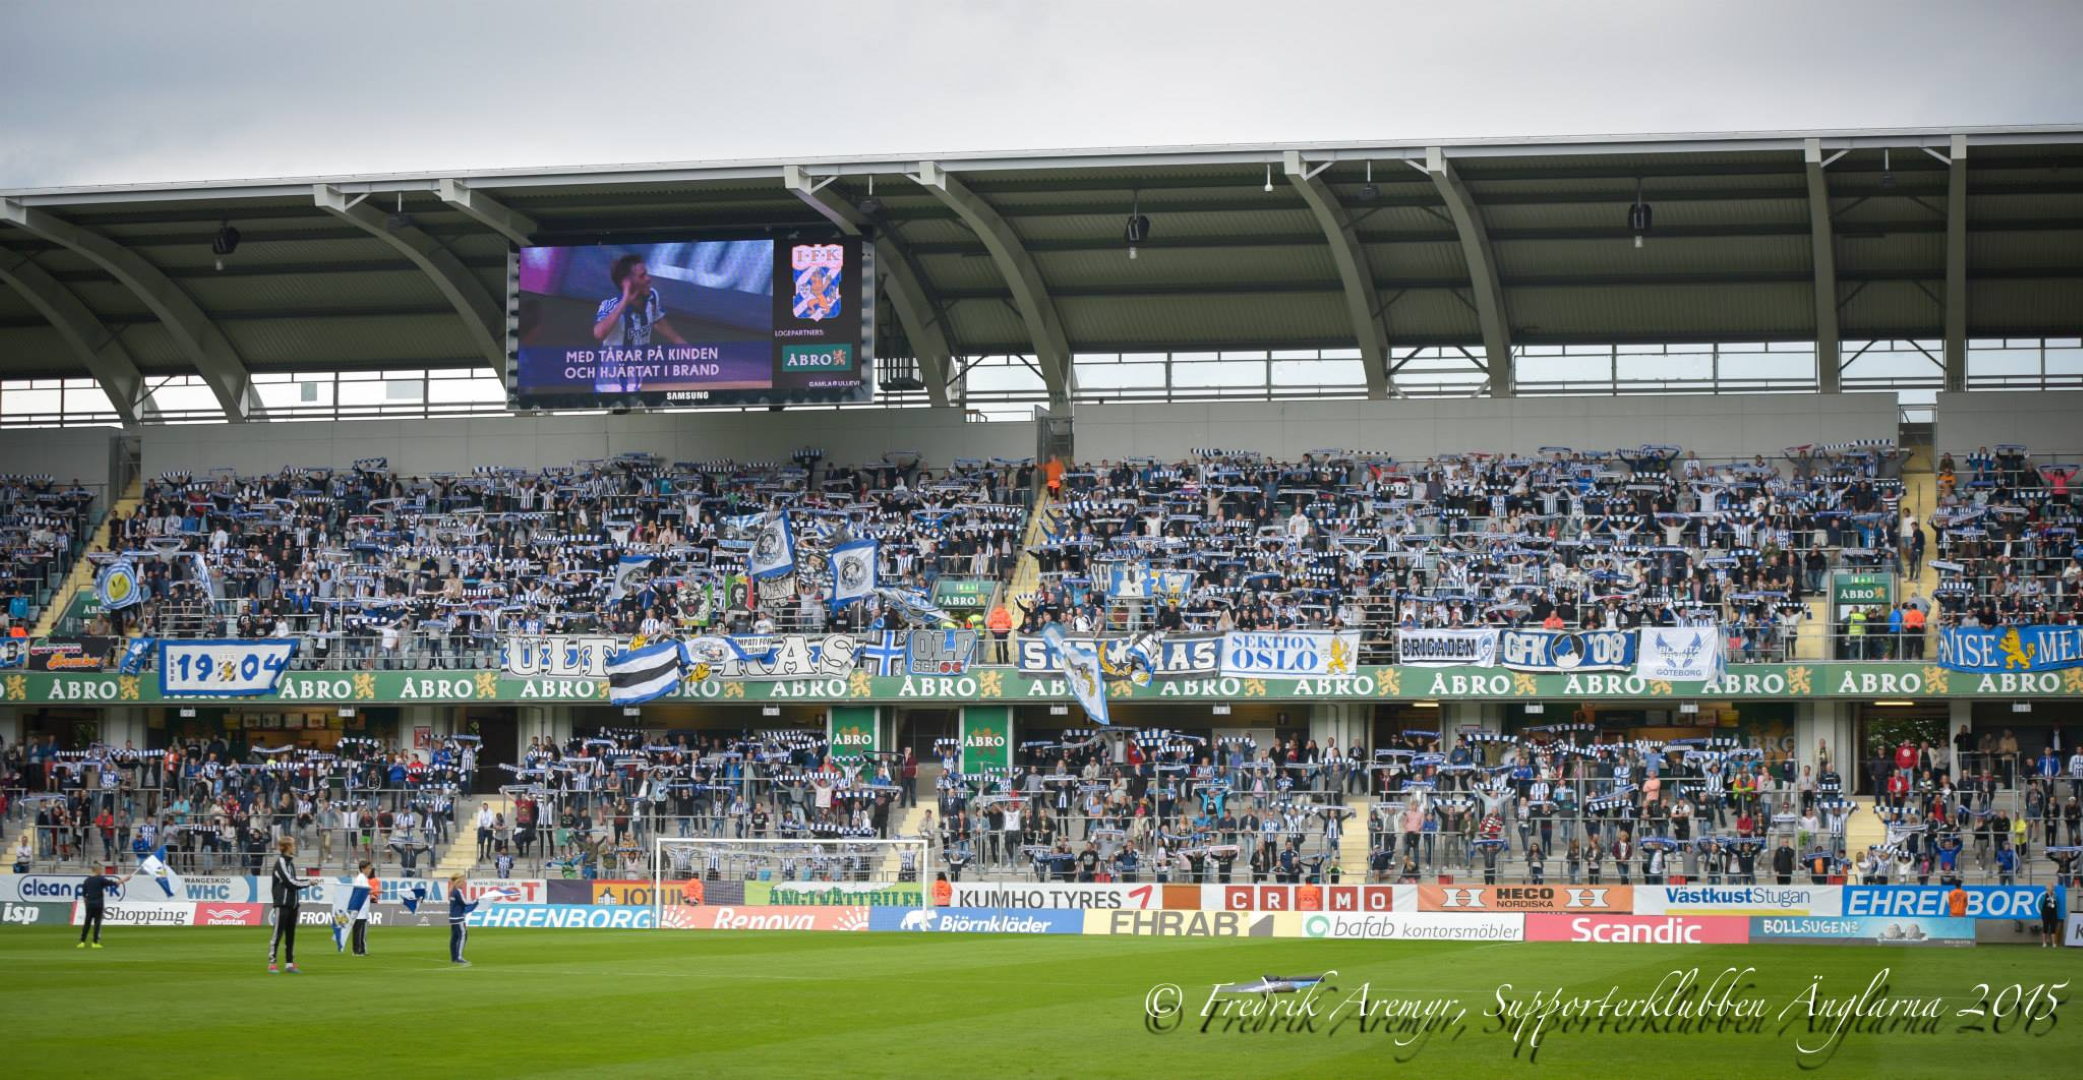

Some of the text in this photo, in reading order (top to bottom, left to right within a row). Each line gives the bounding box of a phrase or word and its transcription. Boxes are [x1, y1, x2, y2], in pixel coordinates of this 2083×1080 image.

[774, 329, 824, 338] LOGEPARTNERS
[566, 345, 718, 363] MED TÅRAR PÅ KINDEN
[787, 353, 832, 367] ÅBRO
[564, 364, 720, 379] OCH HJÄRTAT I BRAND
[666, 391, 710, 401] SAMSUNG
[943, 595, 977, 606] ÅBRO
[912, 630, 976, 661] OLD
[1231, 634, 1317, 649] SEKTION
[1402, 637, 1477, 659] BRIGADEN
[1503, 631, 1547, 666] GFK
[1938, 626, 1999, 667] NISE
[1231, 648, 1315, 671] OSLO
[1656, 668, 1703, 677] GÖTEBORG
[1838, 670, 1921, 693] ÅBRO
[48, 678, 118, 699] ÅBRO
[280, 677, 352, 699] ÅBRO
[399, 677, 473, 699] ÅBRO
[898, 675, 977, 697] ÅBRO
[1428, 673, 1520, 695] ÅBRO
[22, 880, 72, 897] clean
[184, 877, 232, 885] WANGESKOG
[186, 885, 230, 900] WHC
[299, 886, 324, 901] HC
[959, 890, 1122, 910] KUMHO TYRES
[1496, 888, 1554, 900] HECO
[2, 902, 40, 925] isp
[1496, 900, 1554, 908] NORDISKA
[103, 906, 187, 924] Shopping
[714, 907, 815, 930] Renova
[939, 914, 1053, 933] Björnkläder
[1109, 910, 1240, 937] EHRAB
[1334, 914, 1521, 939] bafab kontorsmöbler
[1571, 917, 1703, 943] Scandic
